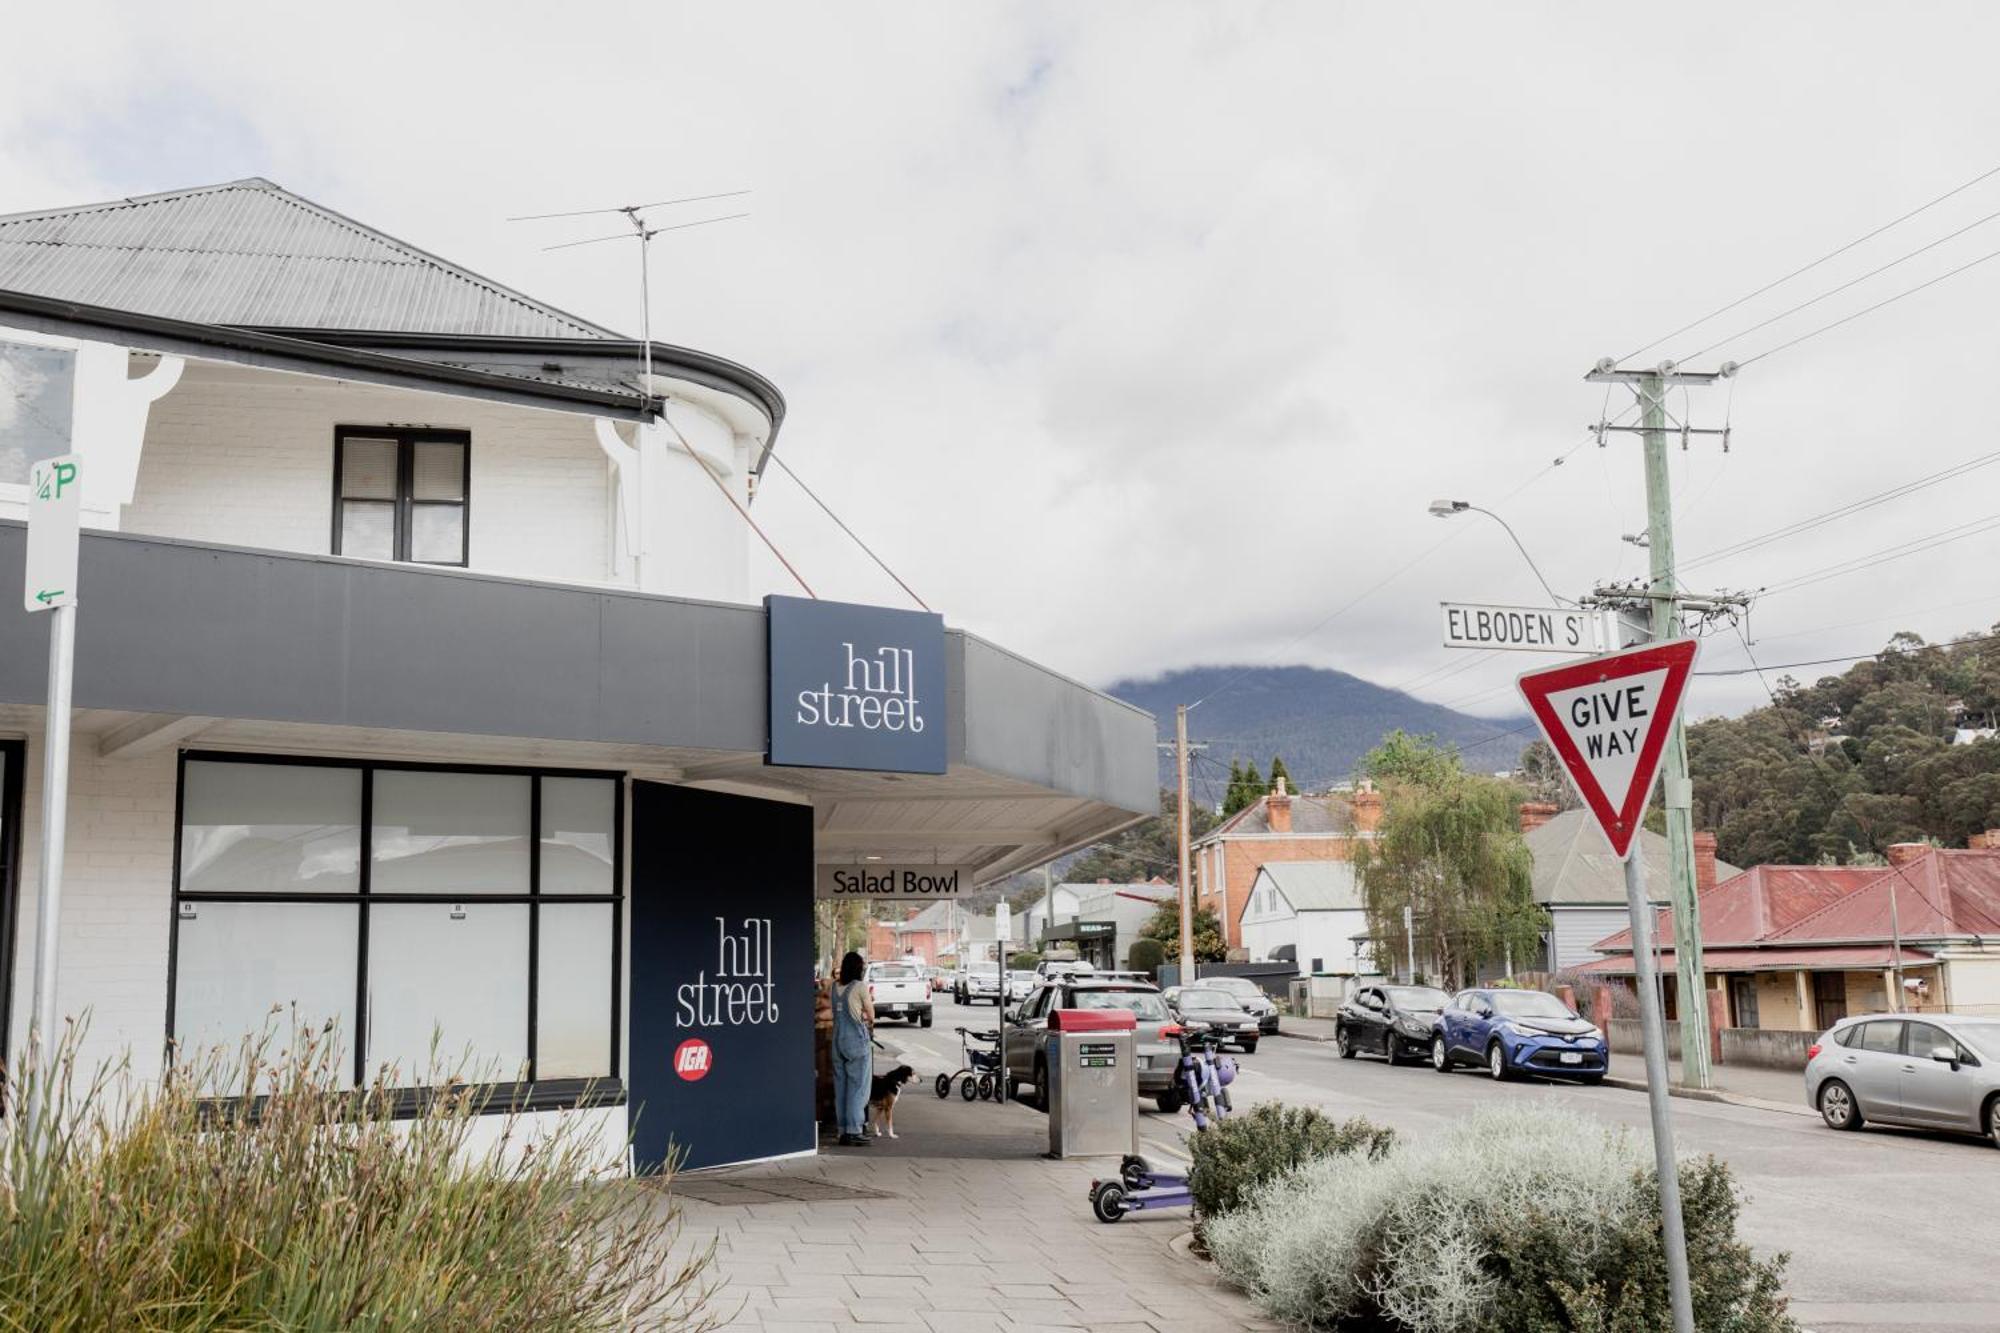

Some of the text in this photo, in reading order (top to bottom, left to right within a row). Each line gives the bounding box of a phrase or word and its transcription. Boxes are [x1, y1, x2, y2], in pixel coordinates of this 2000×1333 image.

[1449, 609, 1554, 645] ELBODEN
[842, 642, 913, 694] hill
[797, 682, 924, 732] street
[1571, 685, 1648, 728] GIVE
[1586, 727, 1639, 759] WAY
[833, 869, 959, 893] Salad Bowl
[715, 917, 772, 977] hill
[676, 970, 779, 1027] street
[677, 1045, 708, 1072] IGA
